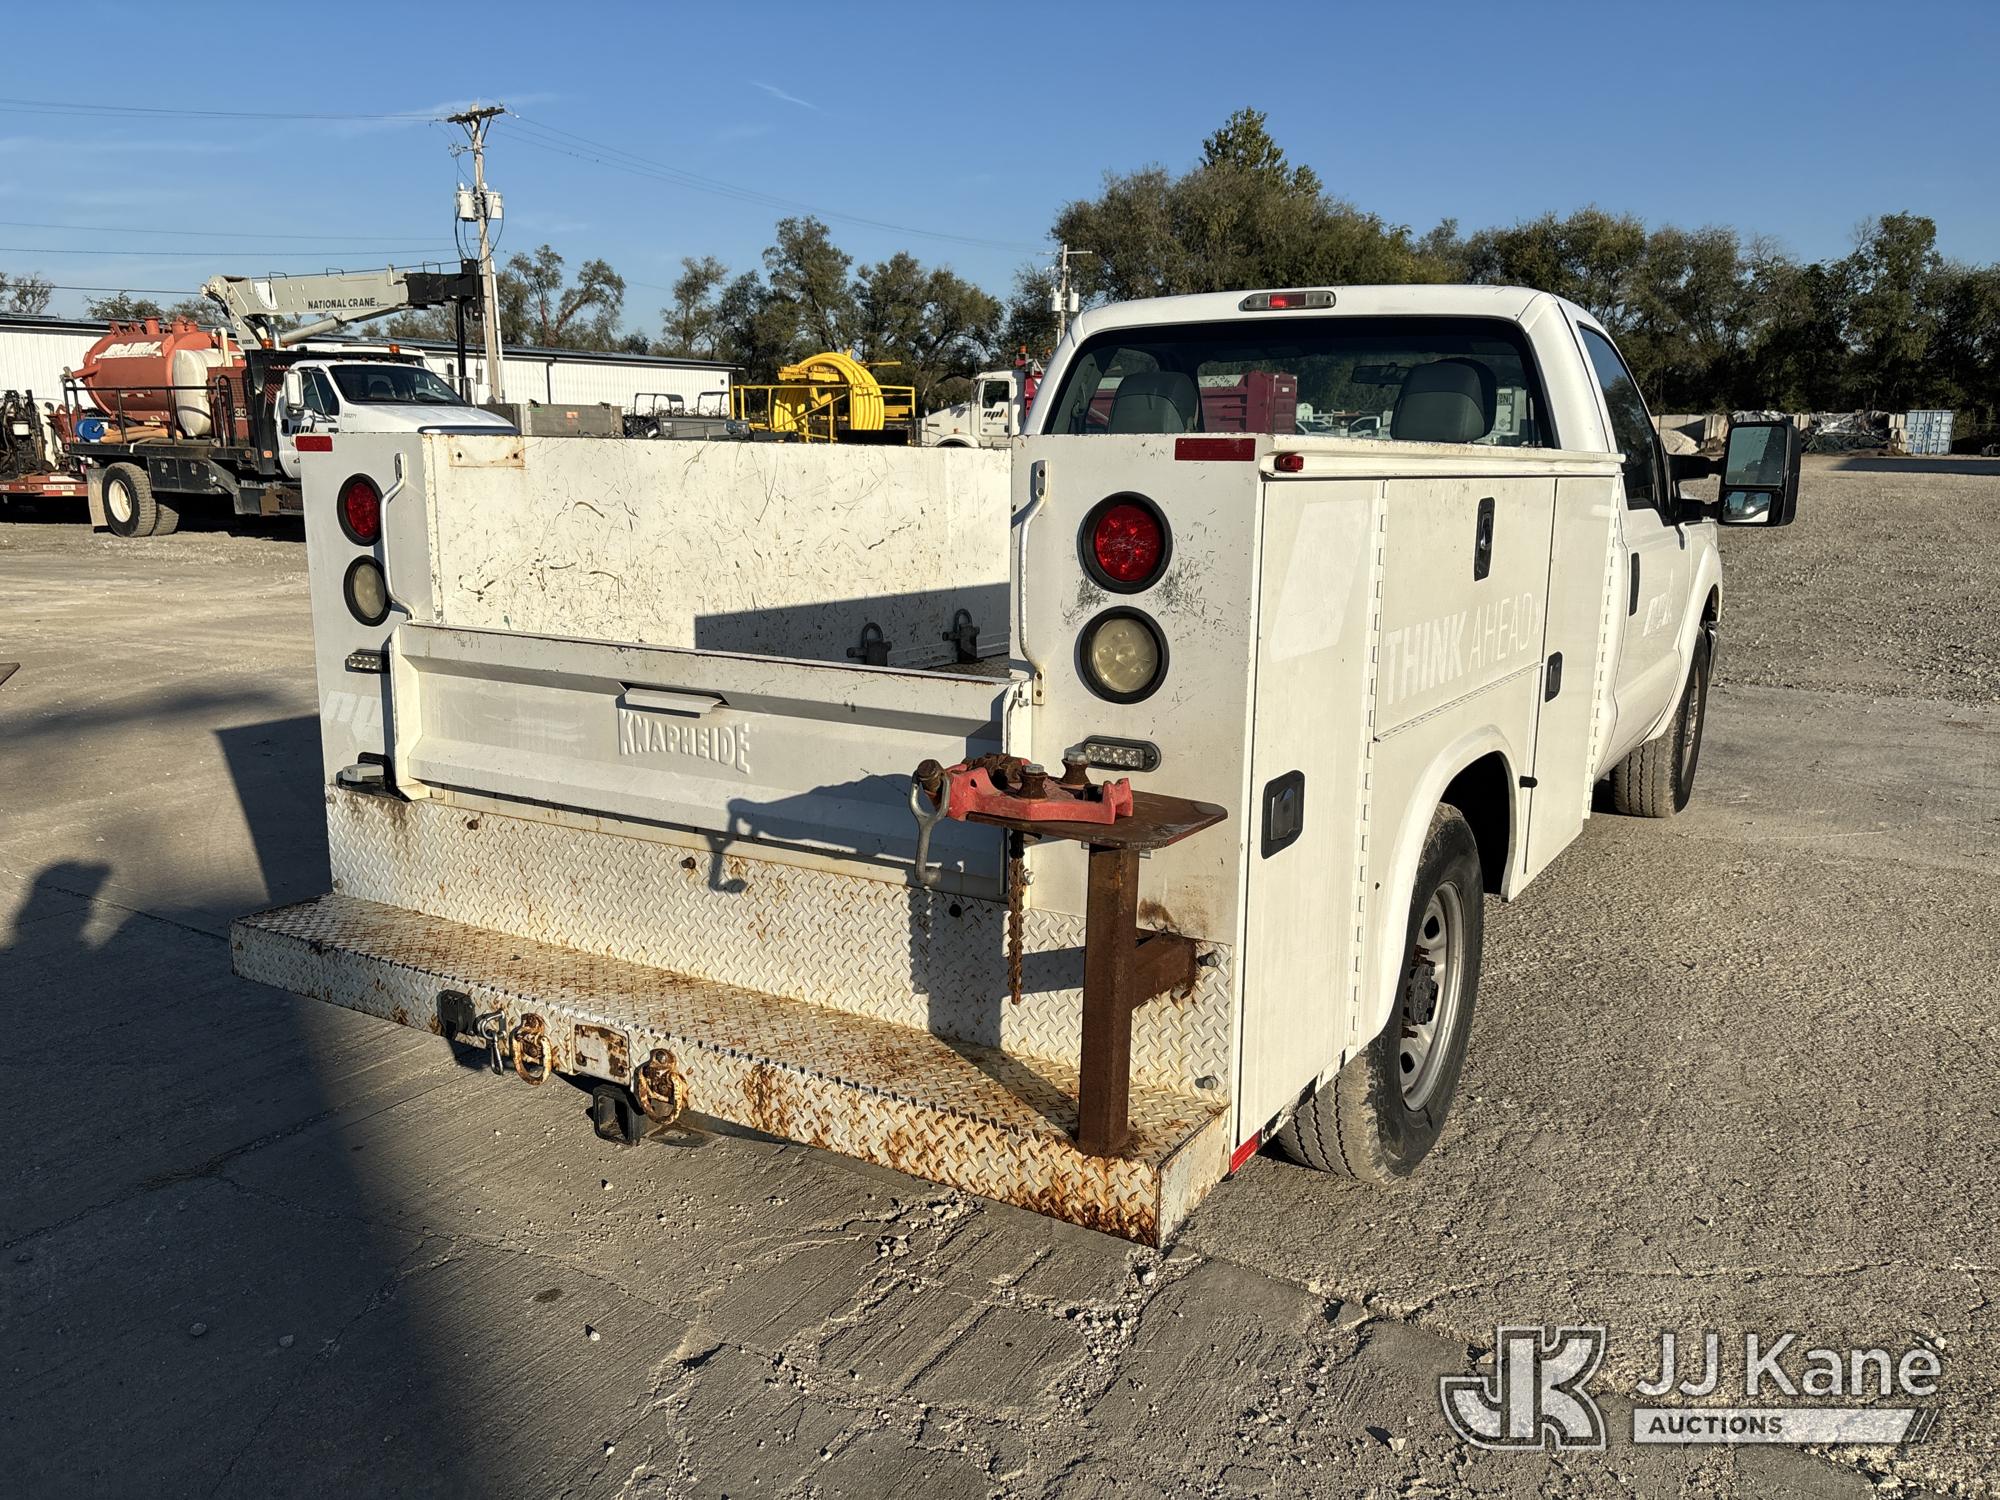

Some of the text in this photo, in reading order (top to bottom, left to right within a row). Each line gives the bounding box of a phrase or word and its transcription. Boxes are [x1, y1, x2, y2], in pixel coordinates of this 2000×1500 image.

[308, 299, 347, 309] NATIONAL
[348, 297, 376, 307] CRANE
[1385, 592, 1533, 705] THINK AHEAD
[618, 708, 751, 775] KNAPHEIDE
